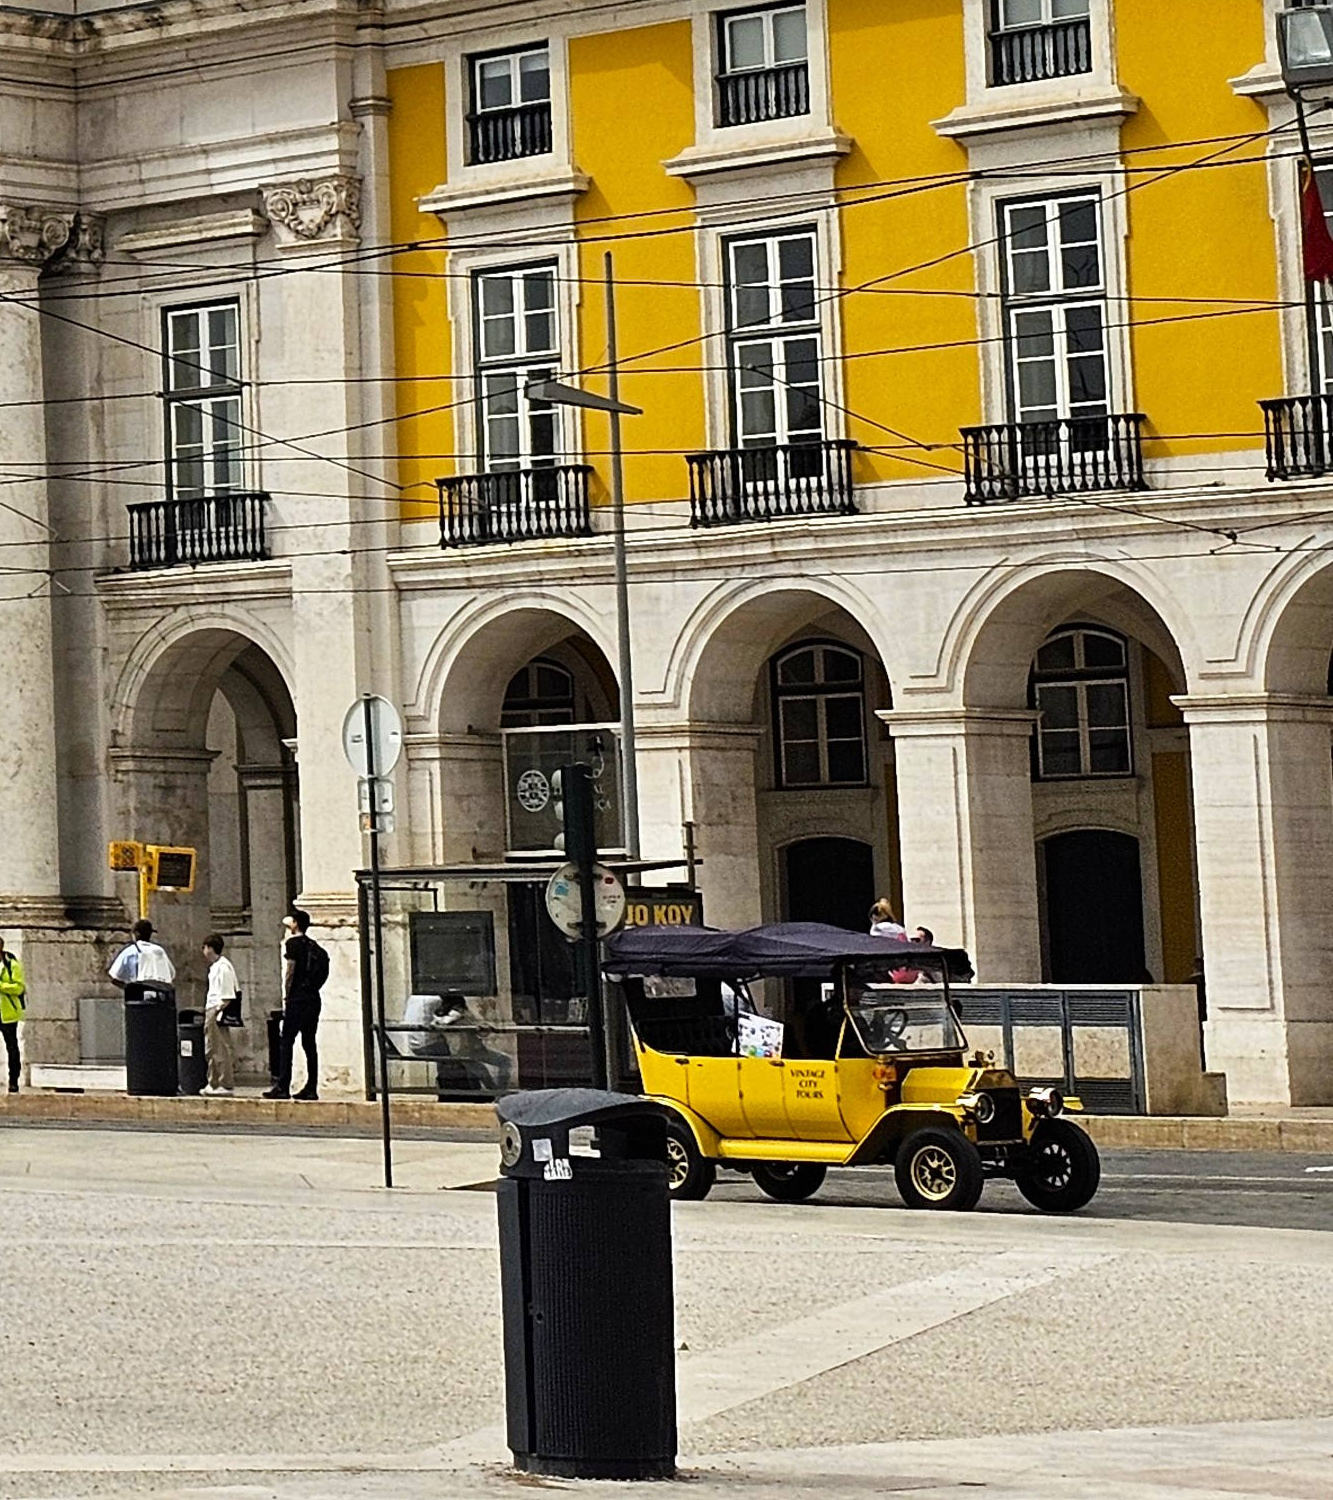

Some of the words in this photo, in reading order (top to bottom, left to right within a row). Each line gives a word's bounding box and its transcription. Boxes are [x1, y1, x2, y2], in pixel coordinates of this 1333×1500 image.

[625, 904, 648, 926] JO
[653, 904, 694, 926] KOY
[798, 1079, 817, 1088] CITY
